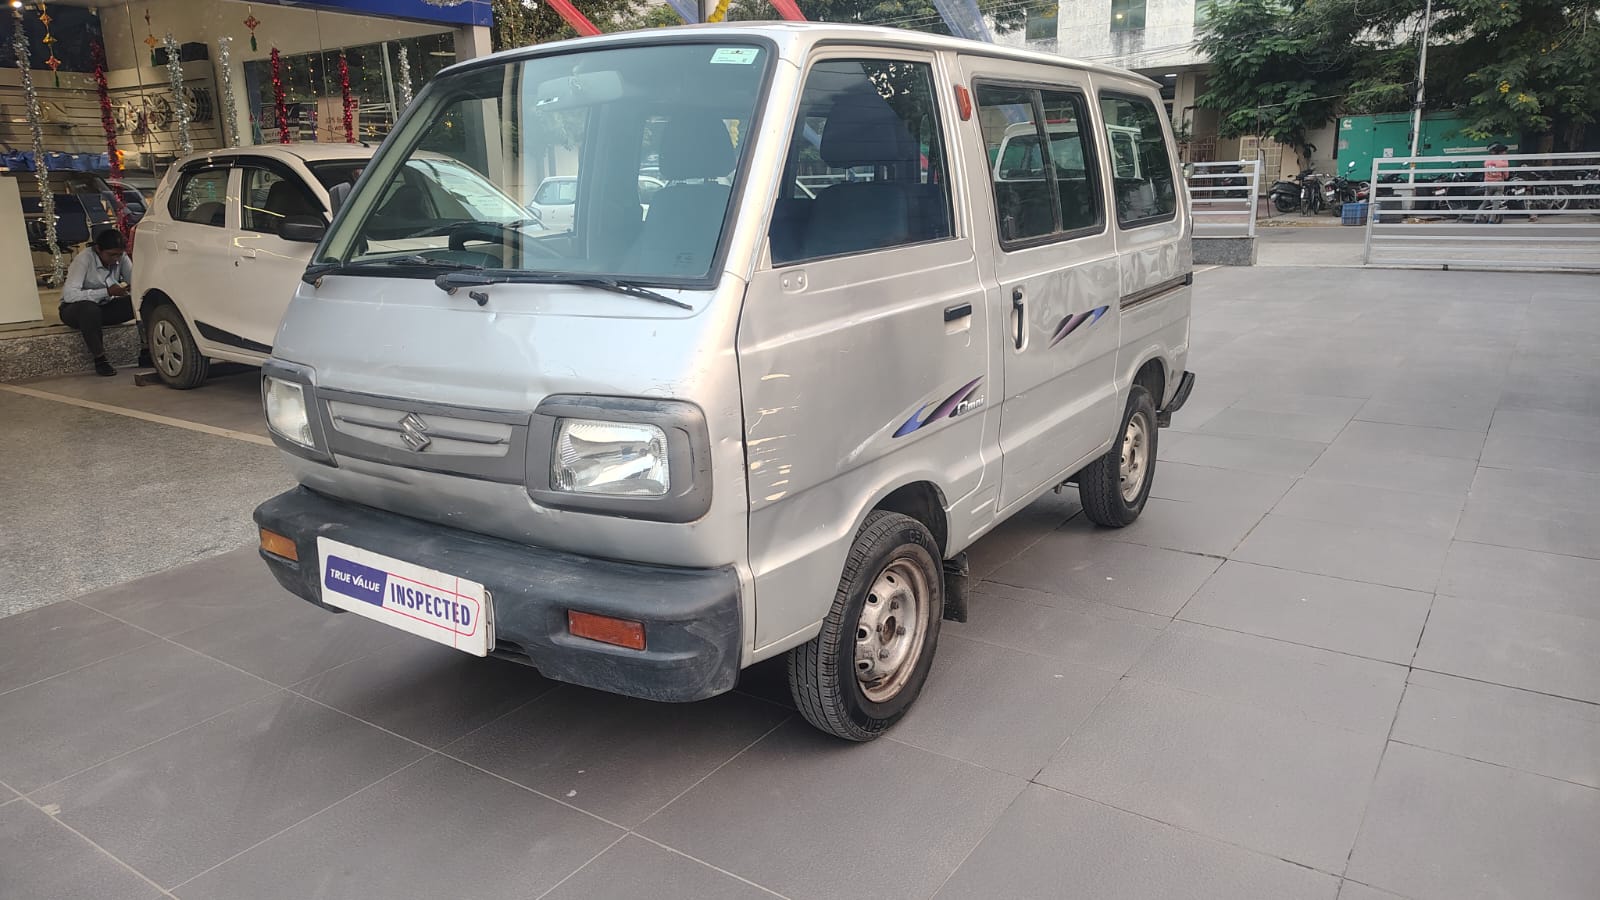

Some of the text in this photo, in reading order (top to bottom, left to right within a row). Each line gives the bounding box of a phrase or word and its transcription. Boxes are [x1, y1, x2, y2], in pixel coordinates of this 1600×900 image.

[957, 394, 984, 416] Omni
[330, 568, 471, 626] TRUE VALUE INSPECTED
